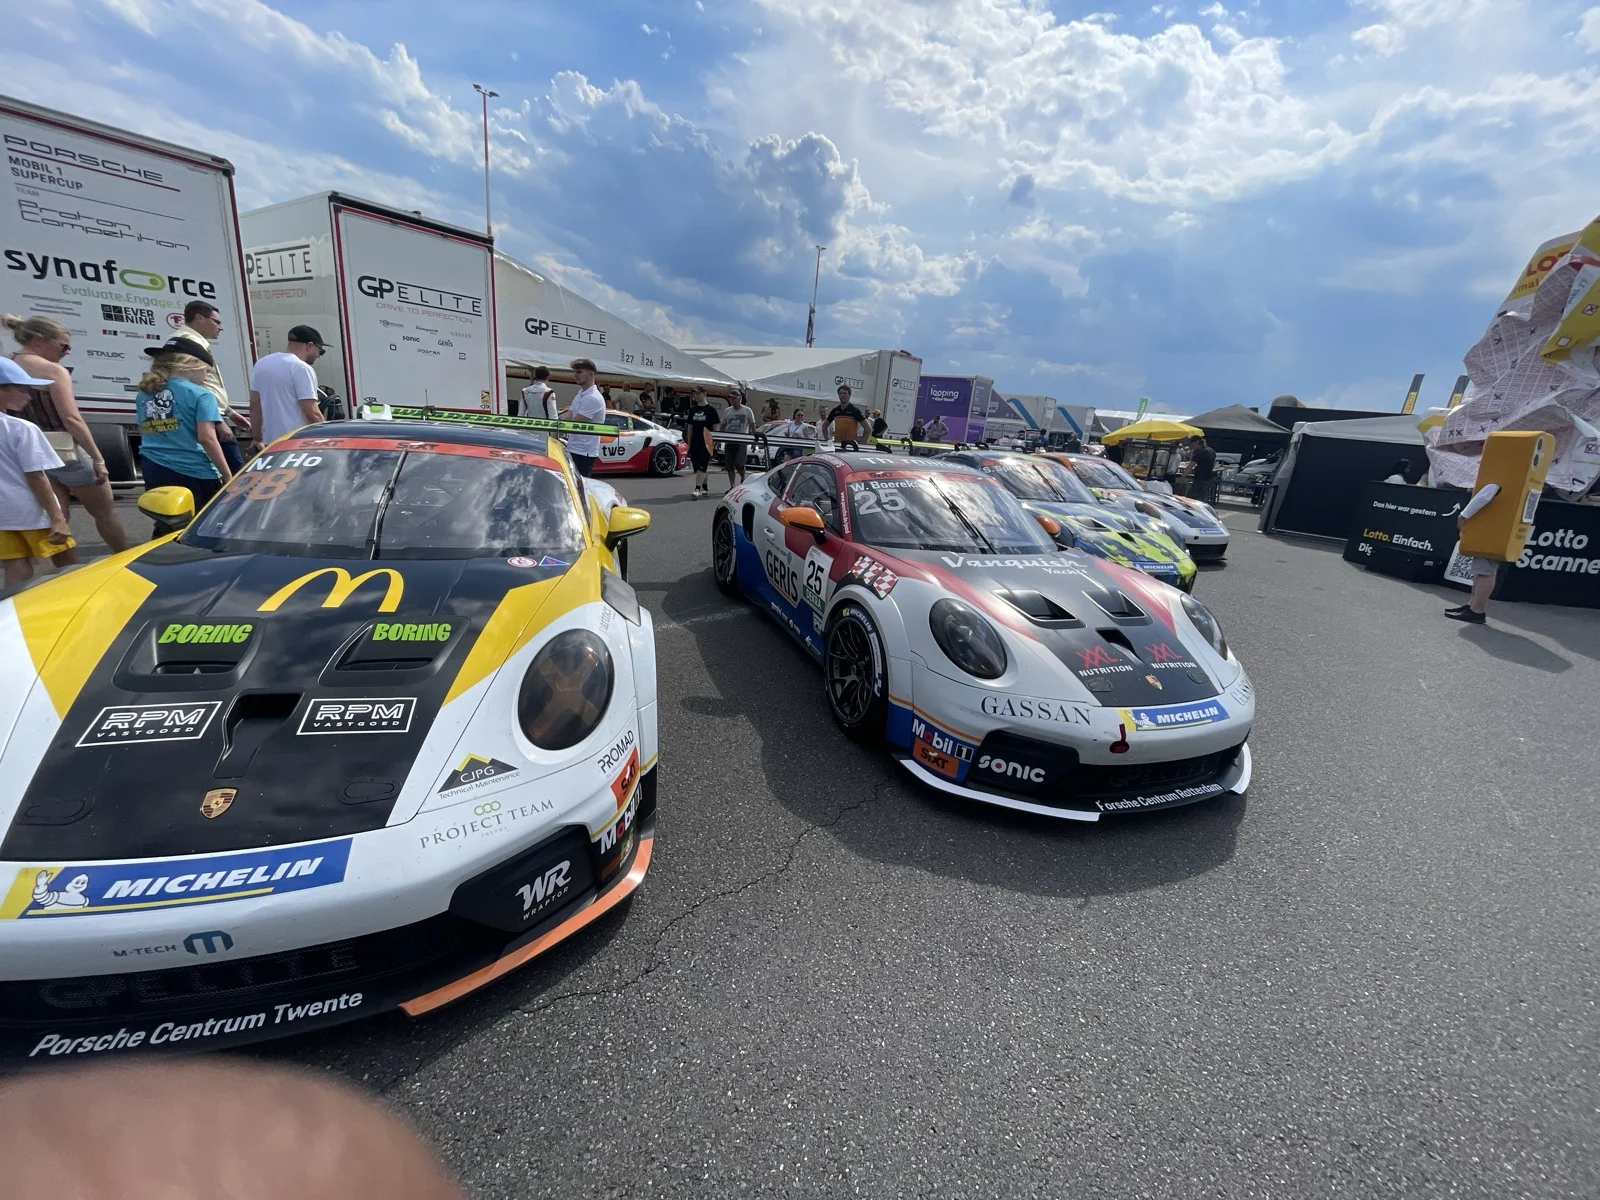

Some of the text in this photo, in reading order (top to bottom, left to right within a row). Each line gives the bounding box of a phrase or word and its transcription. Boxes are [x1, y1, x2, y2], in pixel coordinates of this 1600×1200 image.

[4, 134, 163, 182] PORSCHE
[8, 155, 63, 176] MOBIL 1
[10, 167, 83, 190] SUPERCUP
[18, 199, 131, 230] Proton
[20, 210, 190, 250] Competition
[124, 307, 155, 319] EVER
[125, 316, 156, 327] NINE
[376, 302, 473, 324] DRIVE TO PERFECTION
[87, 350, 125, 359] STALOC
[625, 354, 635, 363] 27
[645, 358, 654, 367] 26
[664, 361, 672, 370] 25
[930, 388, 959, 400] looping
[299, 438, 528, 461] SIXT SIXT SIXT
[245, 453, 323, 473] N. Ho
[221, 468, 298, 504] 98
[850, 483, 870, 492] W.
[854, 488, 906, 516] 25
[1373, 501, 1385, 509] Das
[1385, 502, 1397, 511] hier
[1410, 506, 1437, 517] gestern
[1363, 528, 1434, 552] Lotto. Einfach.
[941, 555, 1087, 569] Vanquish
[1043, 567, 1087, 576] Yachts
[766, 549, 798, 602] GERIS
[807, 560, 825, 595] 25
[850, 609, 873, 632] MICHELIN
[158, 623, 253, 644] BORING
[371, 623, 452, 642] BORING
[1079, 664, 1133, 677] NUTRITION
[1151, 661, 1197, 670] NUTRITION
[101, 708, 206, 730] RPM
[315, 703, 405, 720] RPM
[981, 695, 1091, 726] GASSAN
[1156, 706, 1220, 724] MICHELIN
[96, 726, 196, 738] VASTGOED
[313, 720, 400, 728] VASTGOED
[912, 718, 953, 754] Mobil
[597, 730, 634, 774] PROMAD
[920, 747, 949, 769] SIXT
[439, 771, 520, 800] Technical Maintenance
[460, 766, 495, 784] CJPG
[1139, 789, 1180, 807] Centrum
[1176, 782, 1223, 798] Rotterdam
[420, 799, 554, 849] PROJECT TEAM
[103, 857, 324, 899] MICHELIN
[523, 887, 569, 920] WRAPTOR
[112, 944, 177, 957] M-TECH
[29, 992, 363, 1057] Porsche Centrum Twente
